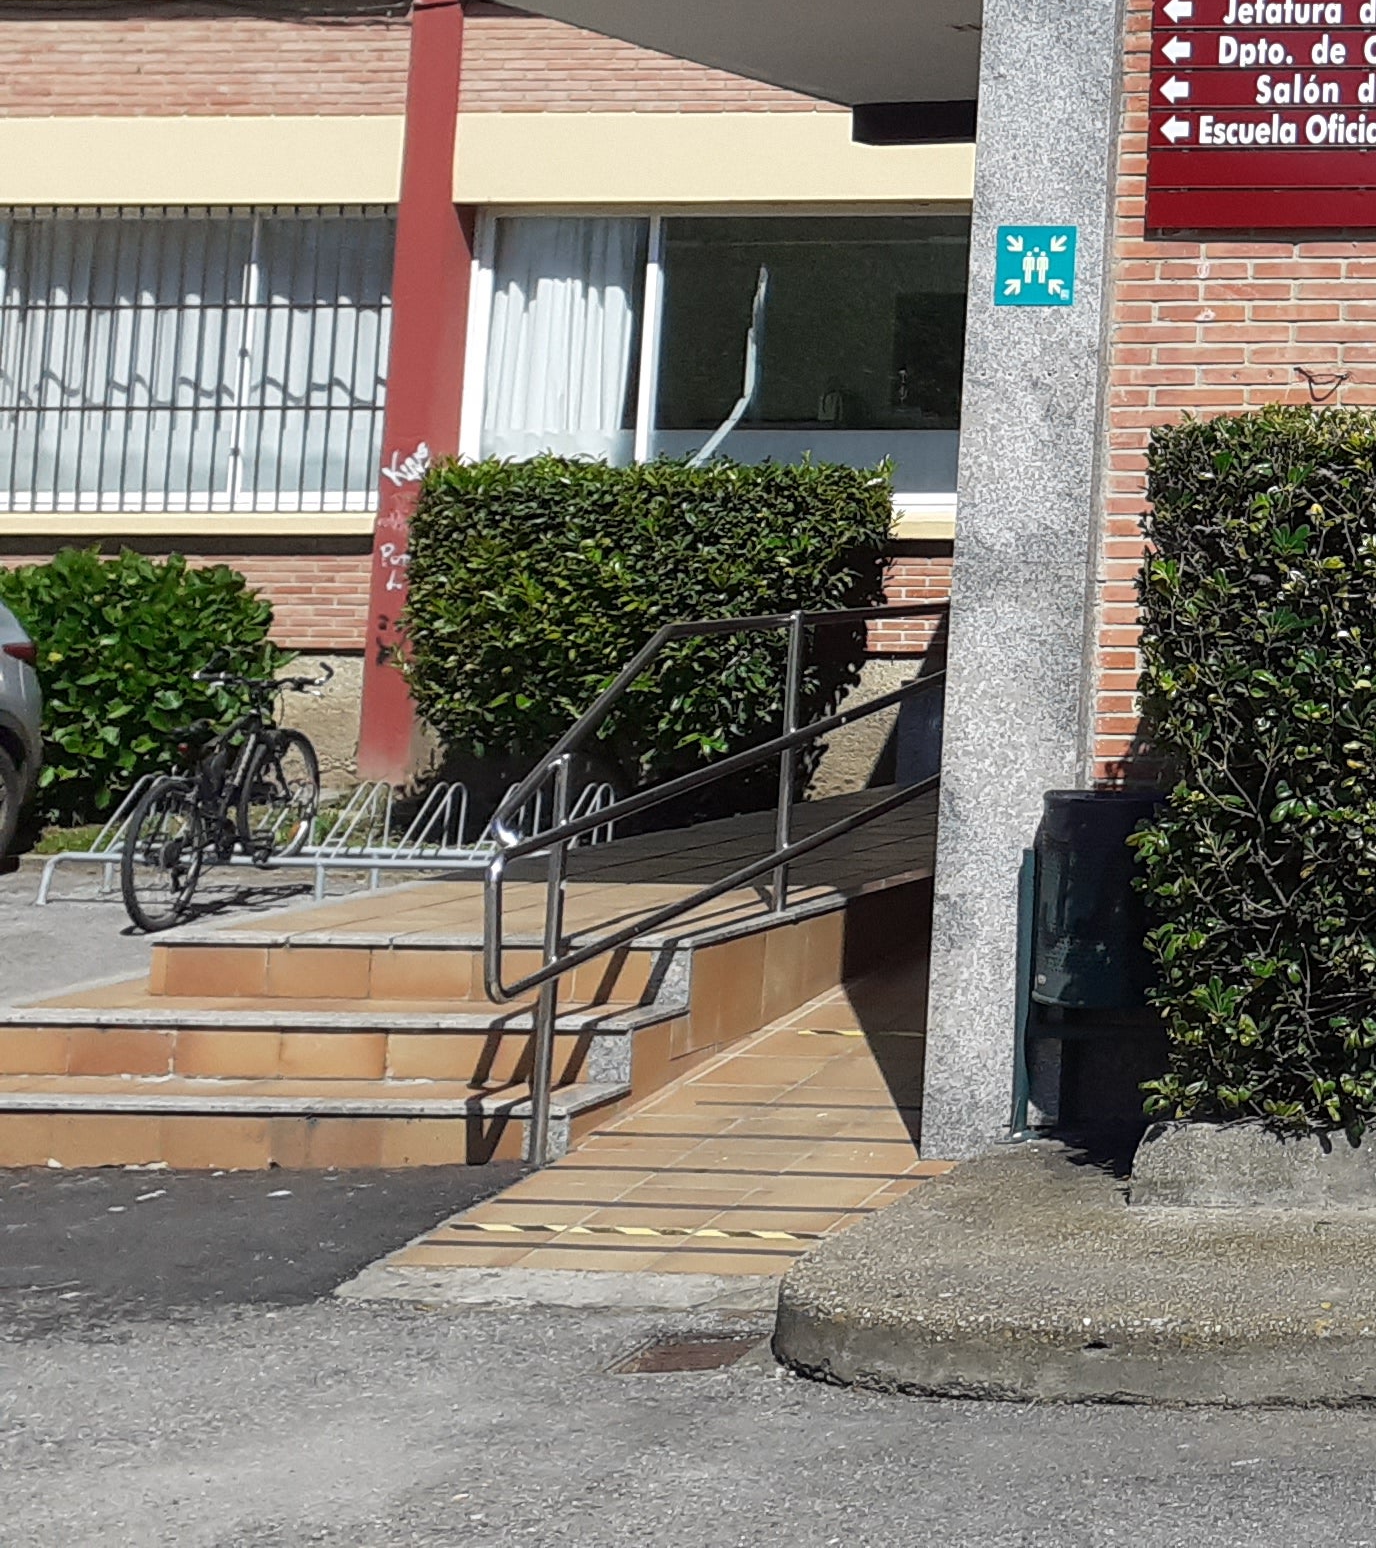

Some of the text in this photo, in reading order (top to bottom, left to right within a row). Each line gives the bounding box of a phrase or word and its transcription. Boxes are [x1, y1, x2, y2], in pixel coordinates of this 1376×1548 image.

[1218, 35, 1294, 68] Dpto.
[1311, 35, 1347, 64] de
[1255, 74, 1339, 104] Salón
[1199, 114, 1296, 145] Escuela
